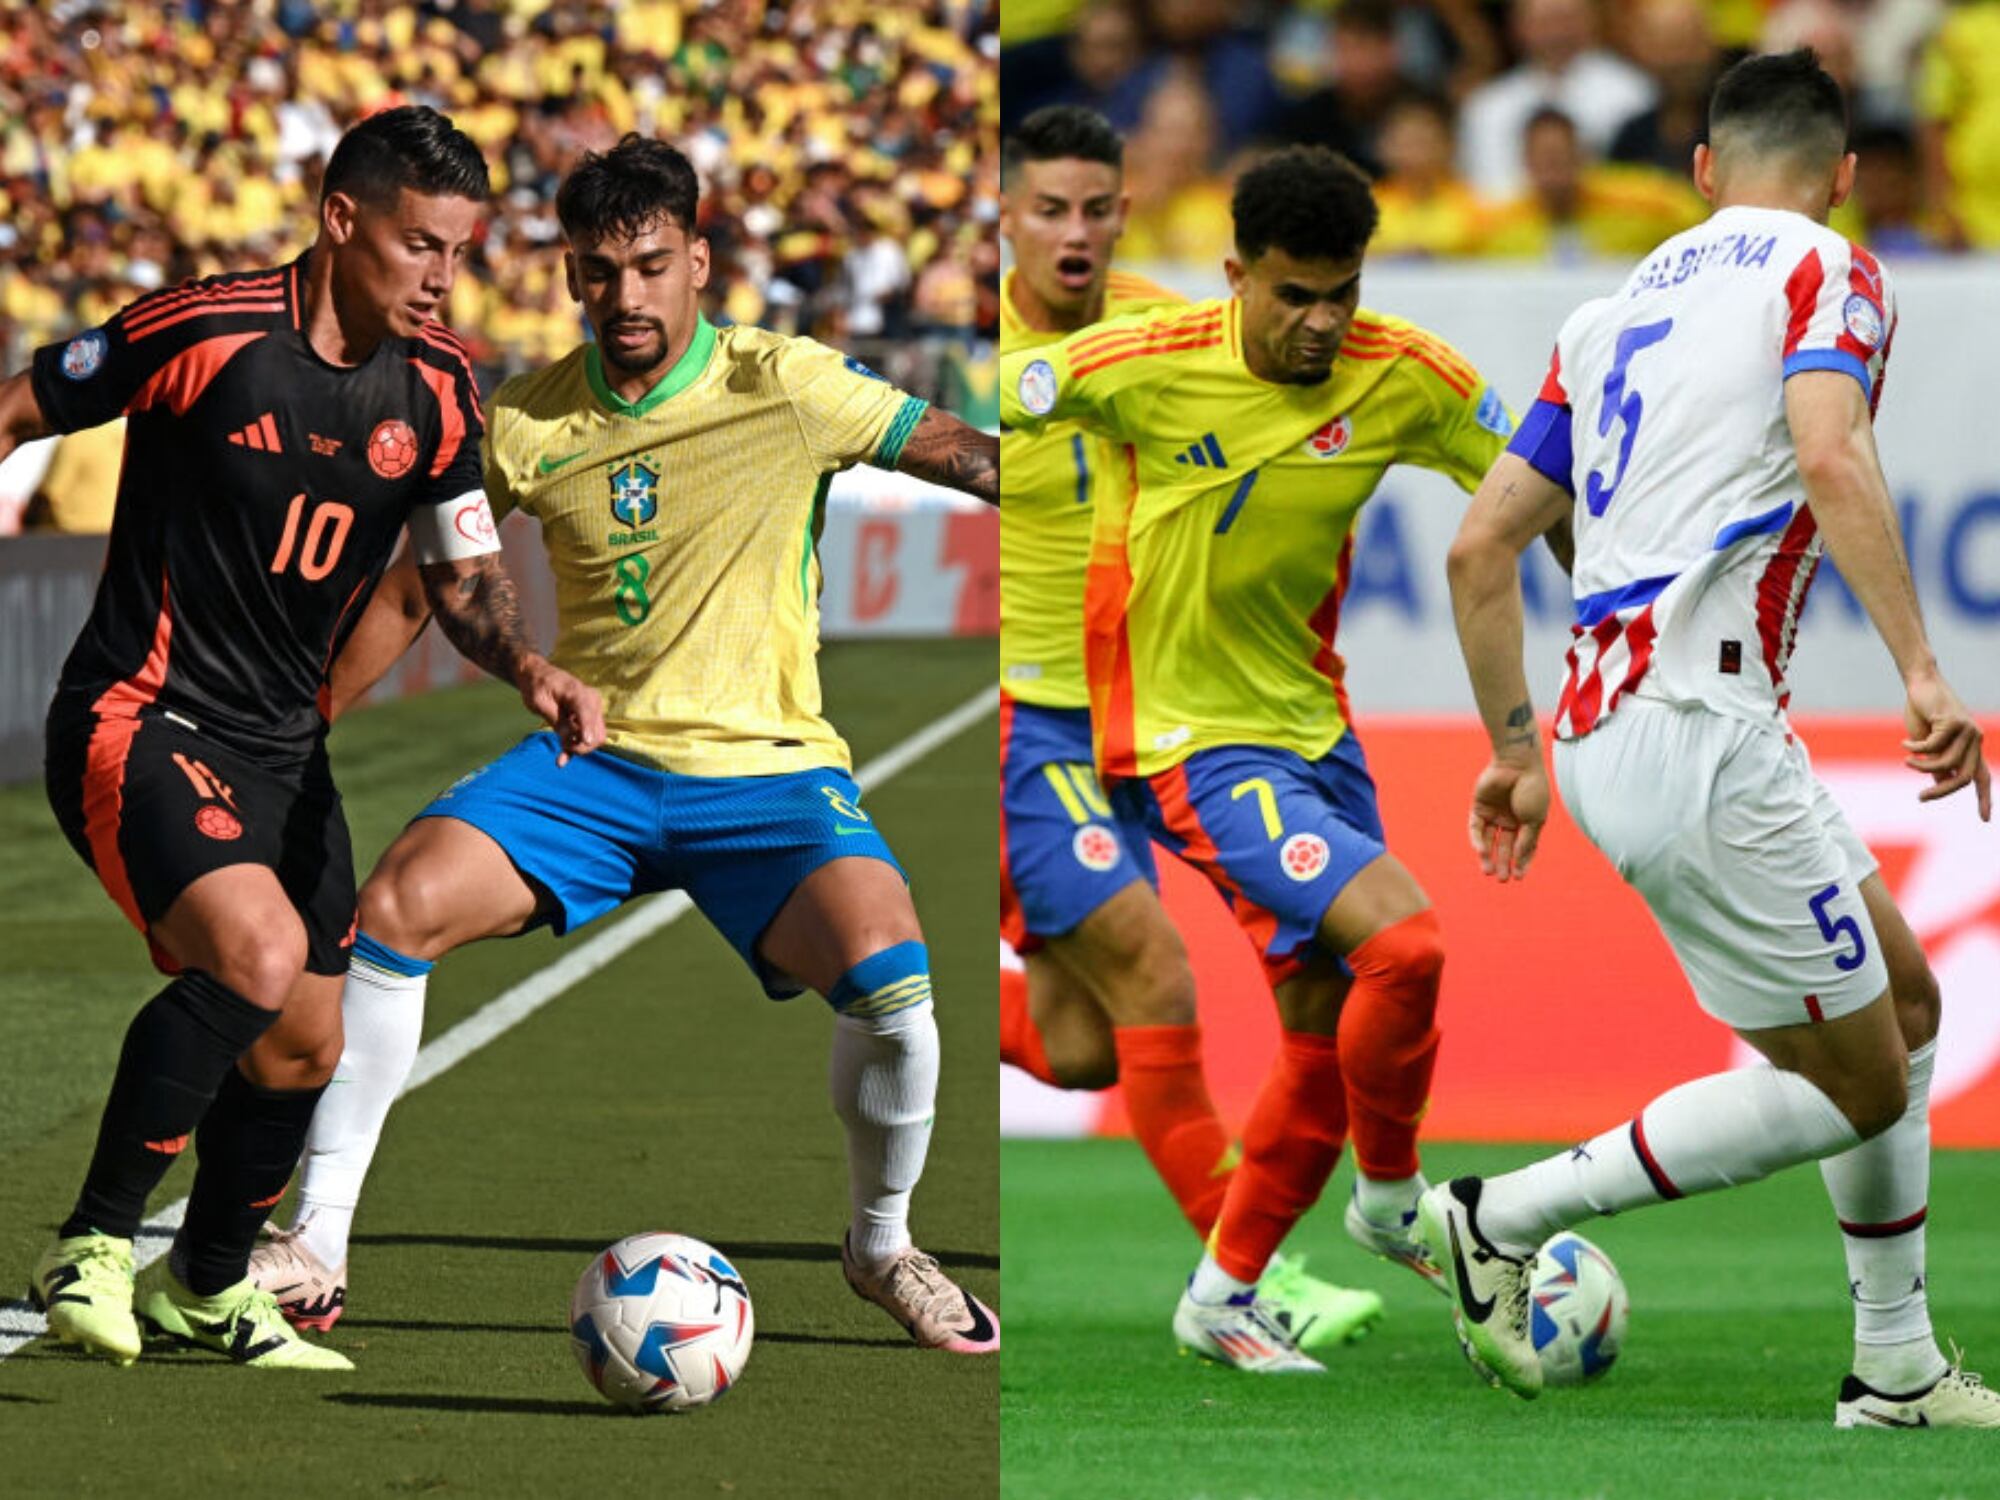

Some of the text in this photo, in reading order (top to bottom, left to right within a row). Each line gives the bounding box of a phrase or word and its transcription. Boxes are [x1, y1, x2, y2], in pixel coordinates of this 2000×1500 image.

[1586, 317, 1673, 518] 5
[270, 493, 354, 582] 10
[608, 529, 659, 546] BRASIL
[614, 553, 651, 627] 8
[821, 786, 868, 822] 8
[1231, 776, 1285, 842] 7
[1808, 884, 1867, 972] 5
